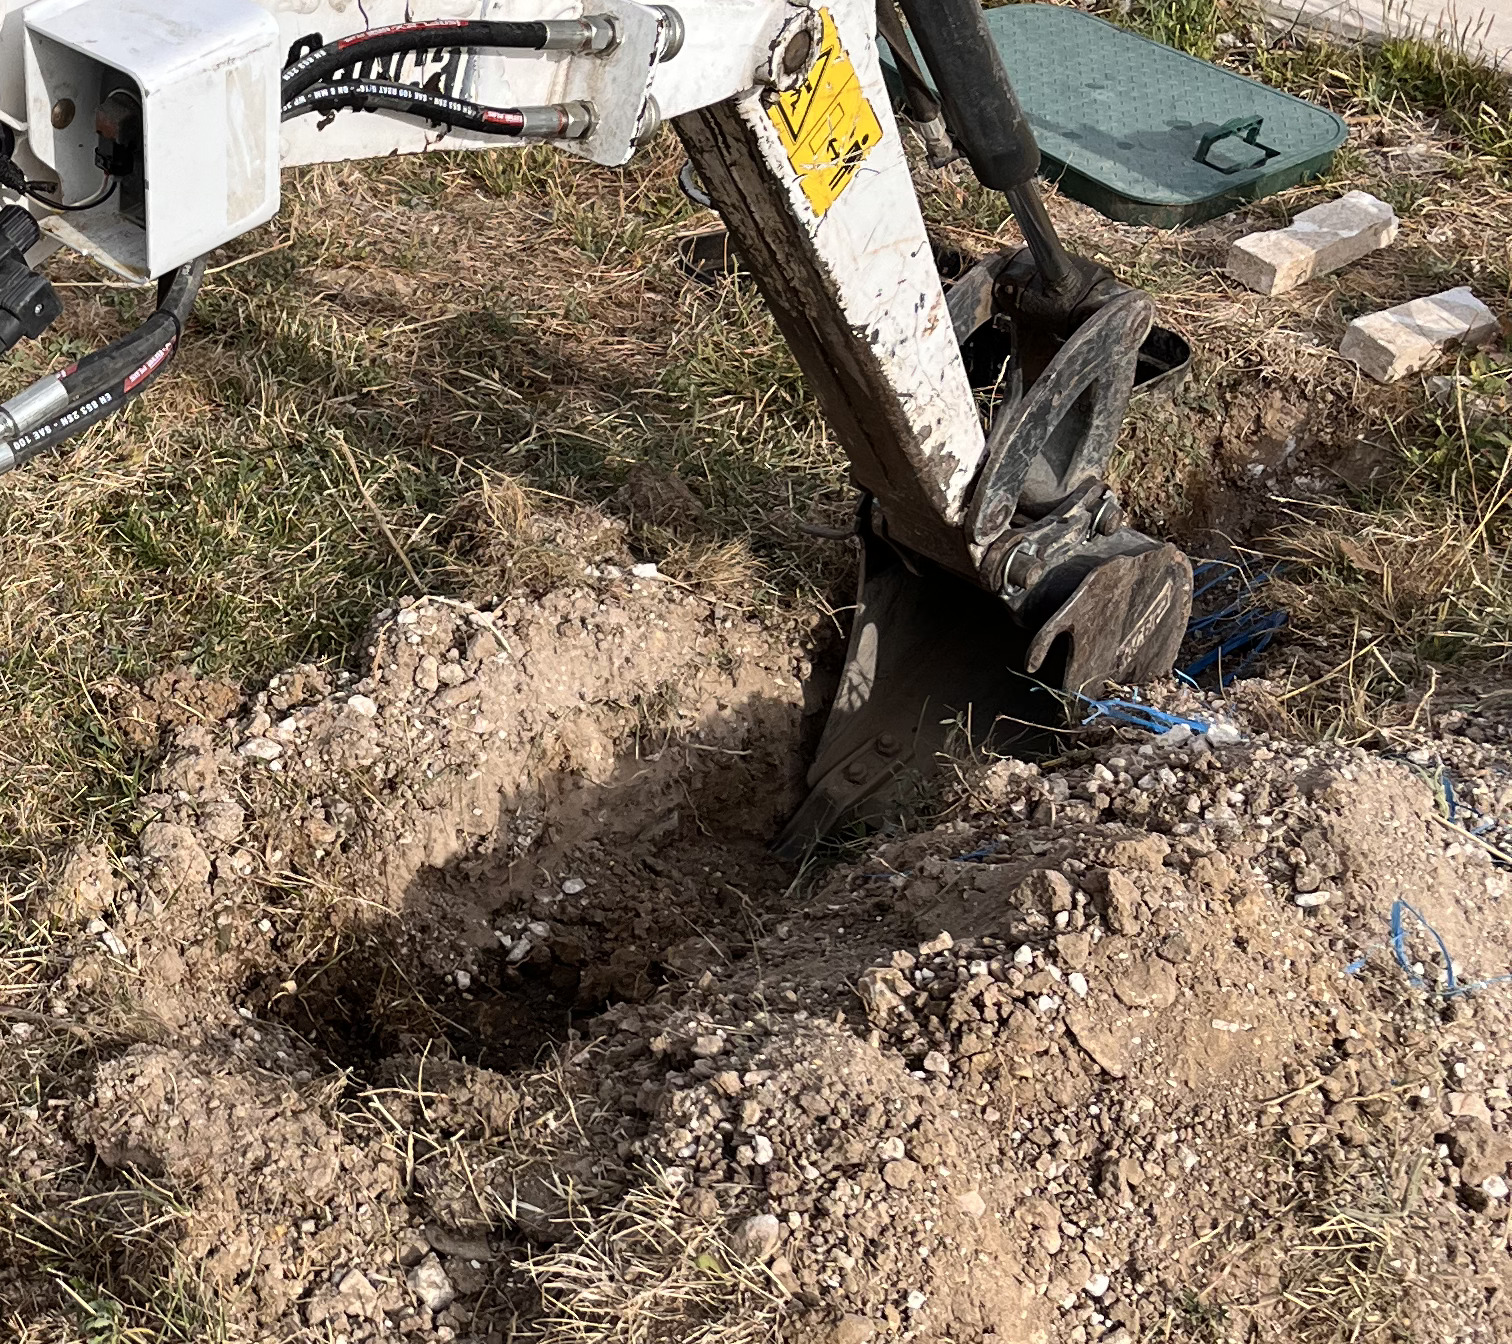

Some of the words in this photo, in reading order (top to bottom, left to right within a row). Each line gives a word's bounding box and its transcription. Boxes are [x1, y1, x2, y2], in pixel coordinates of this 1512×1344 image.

[399, 89, 412, 98] 100
[99, 393, 111, 404] EN
[80, 401, 98, 415] 853
[33, 426, 51, 440] SAE
[13, 436, 31, 450] 100
